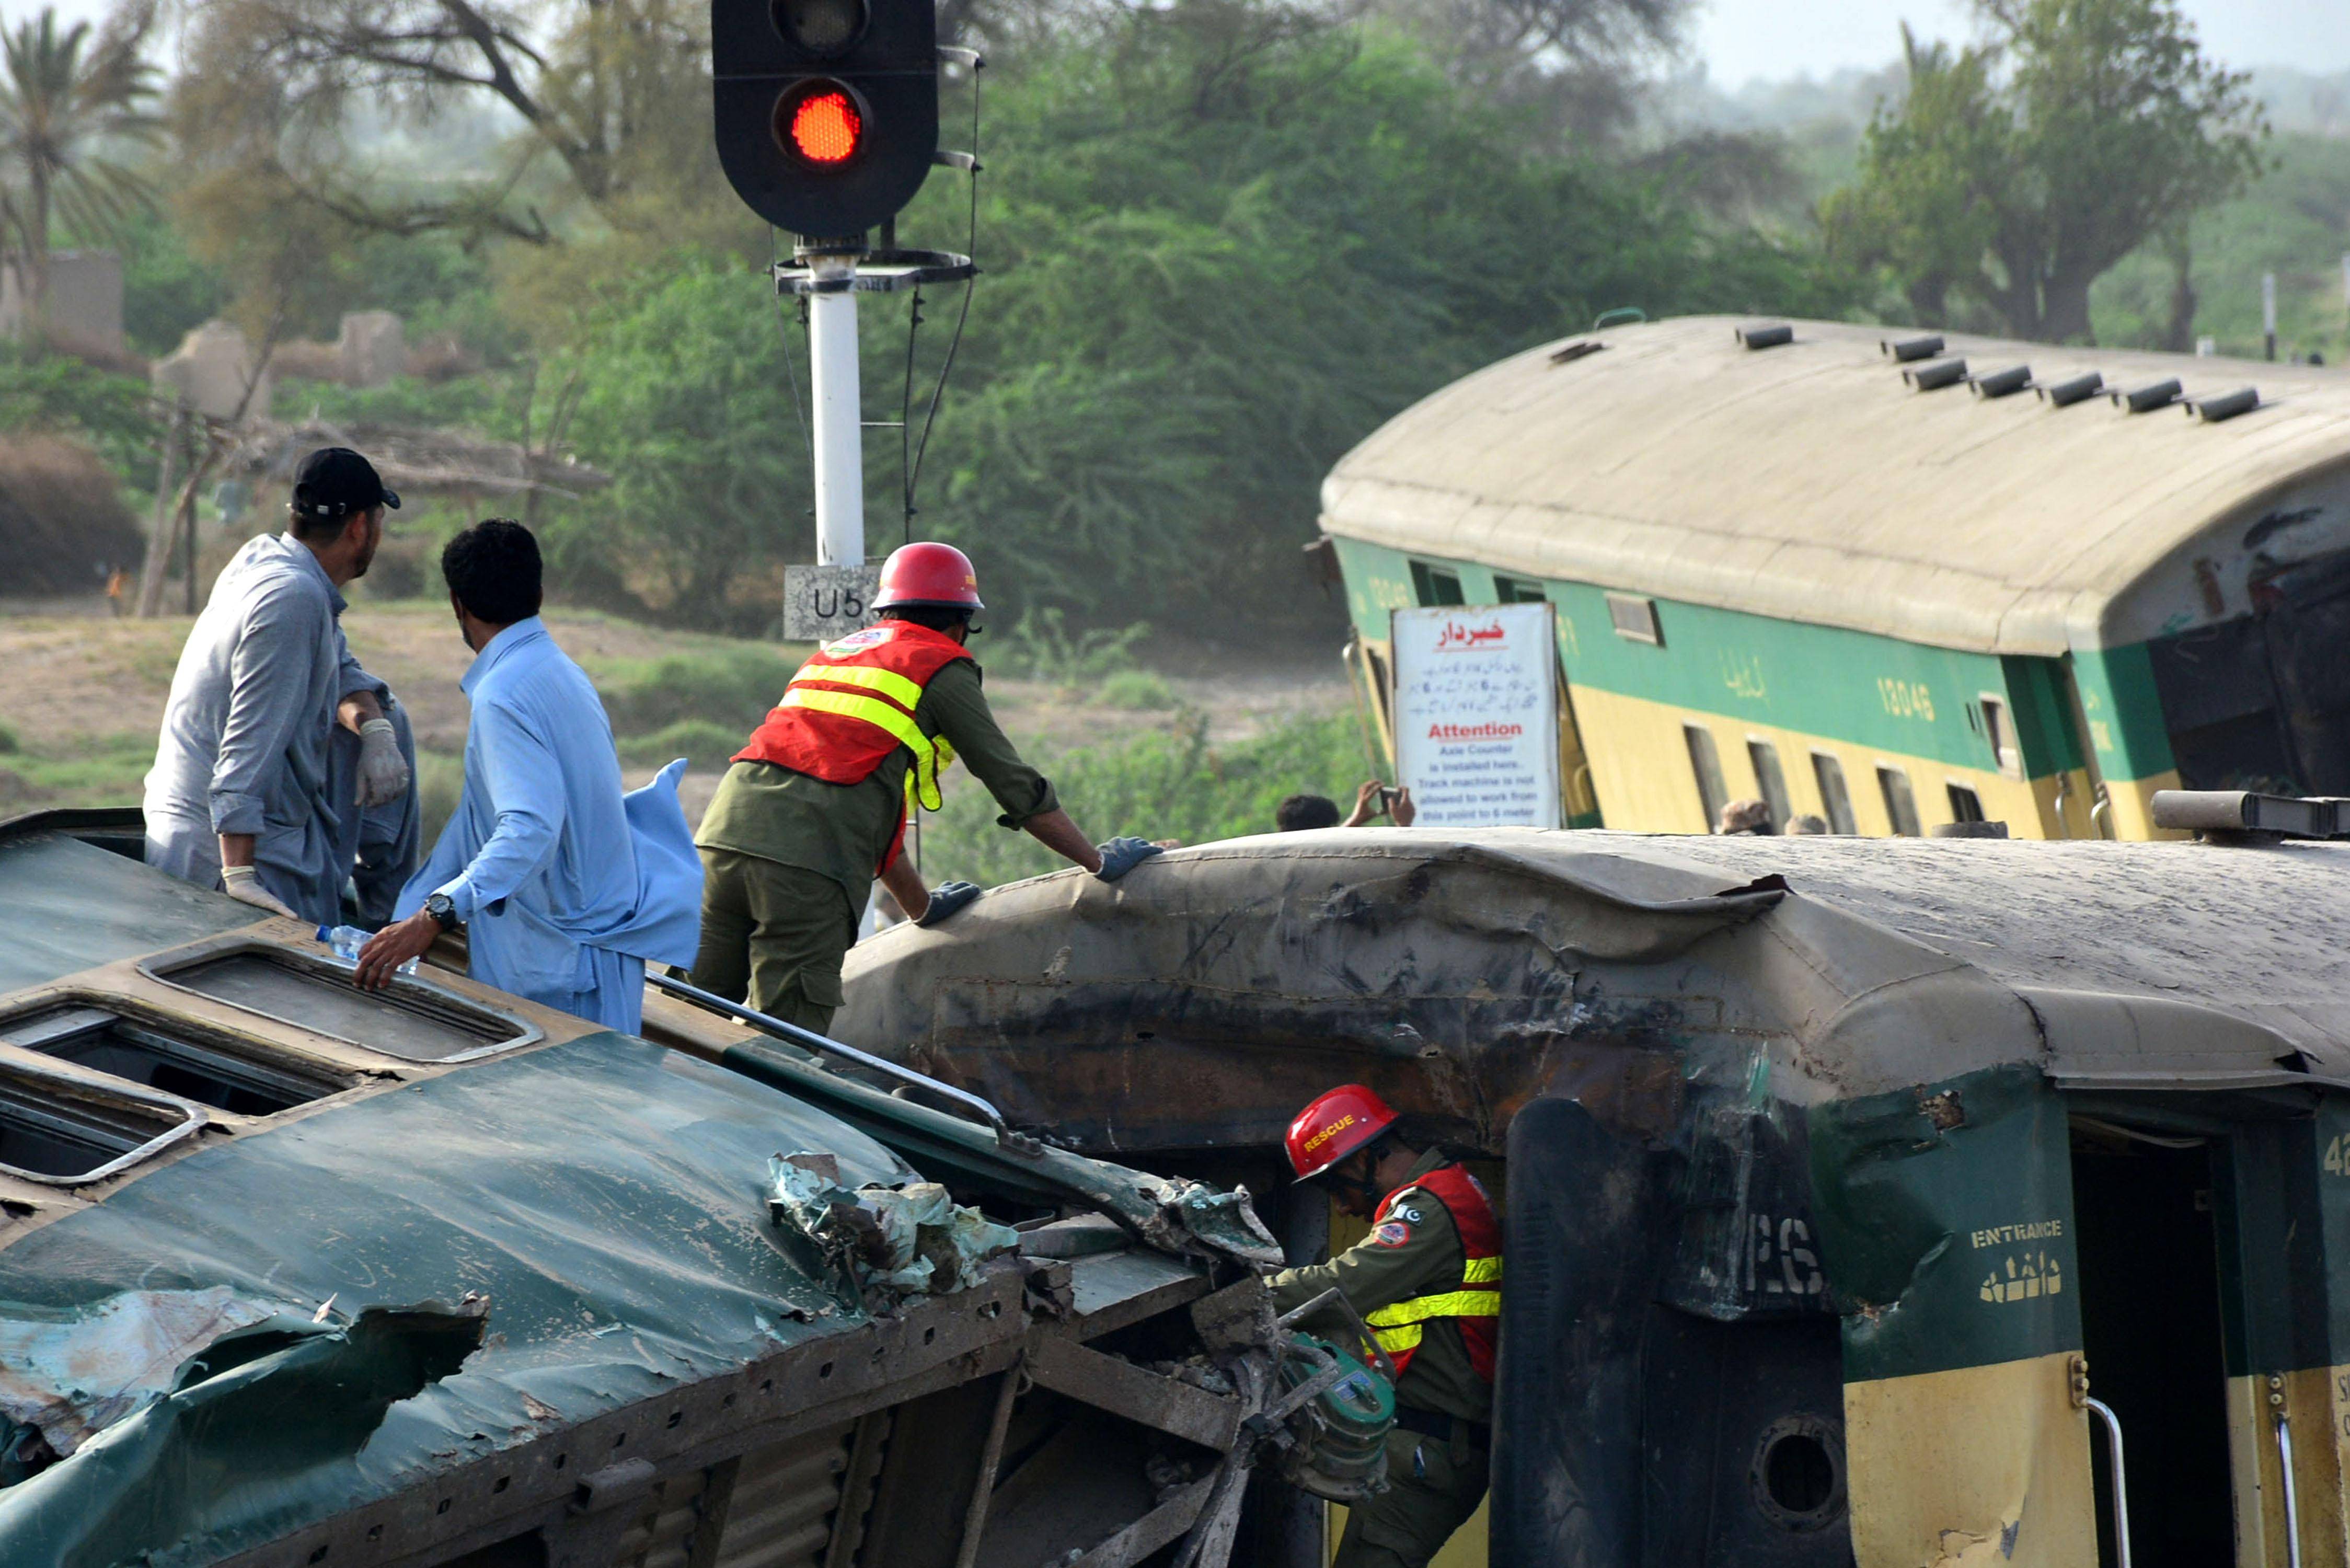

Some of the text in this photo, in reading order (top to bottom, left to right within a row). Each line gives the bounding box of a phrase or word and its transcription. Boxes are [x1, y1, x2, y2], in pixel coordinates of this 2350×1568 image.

[1437, 619, 1505, 646] خبردار
[1427, 722, 1523, 739] Attention
[1468, 744, 1513, 754] Counter
[1442, 762, 1490, 771] installed
[1418, 775, 1535, 788] Track machine is not
[1420, 791, 1537, 805] allowed to work from
[1422, 812, 1443, 821] this
[1447, 811, 1476, 822] point
[1479, 810, 1491, 818] to
[1503, 808, 1535, 817] meter
[1304, 1114, 1355, 1152] RESCUE
[1971, 1219, 2063, 1249] ENTRANCE
